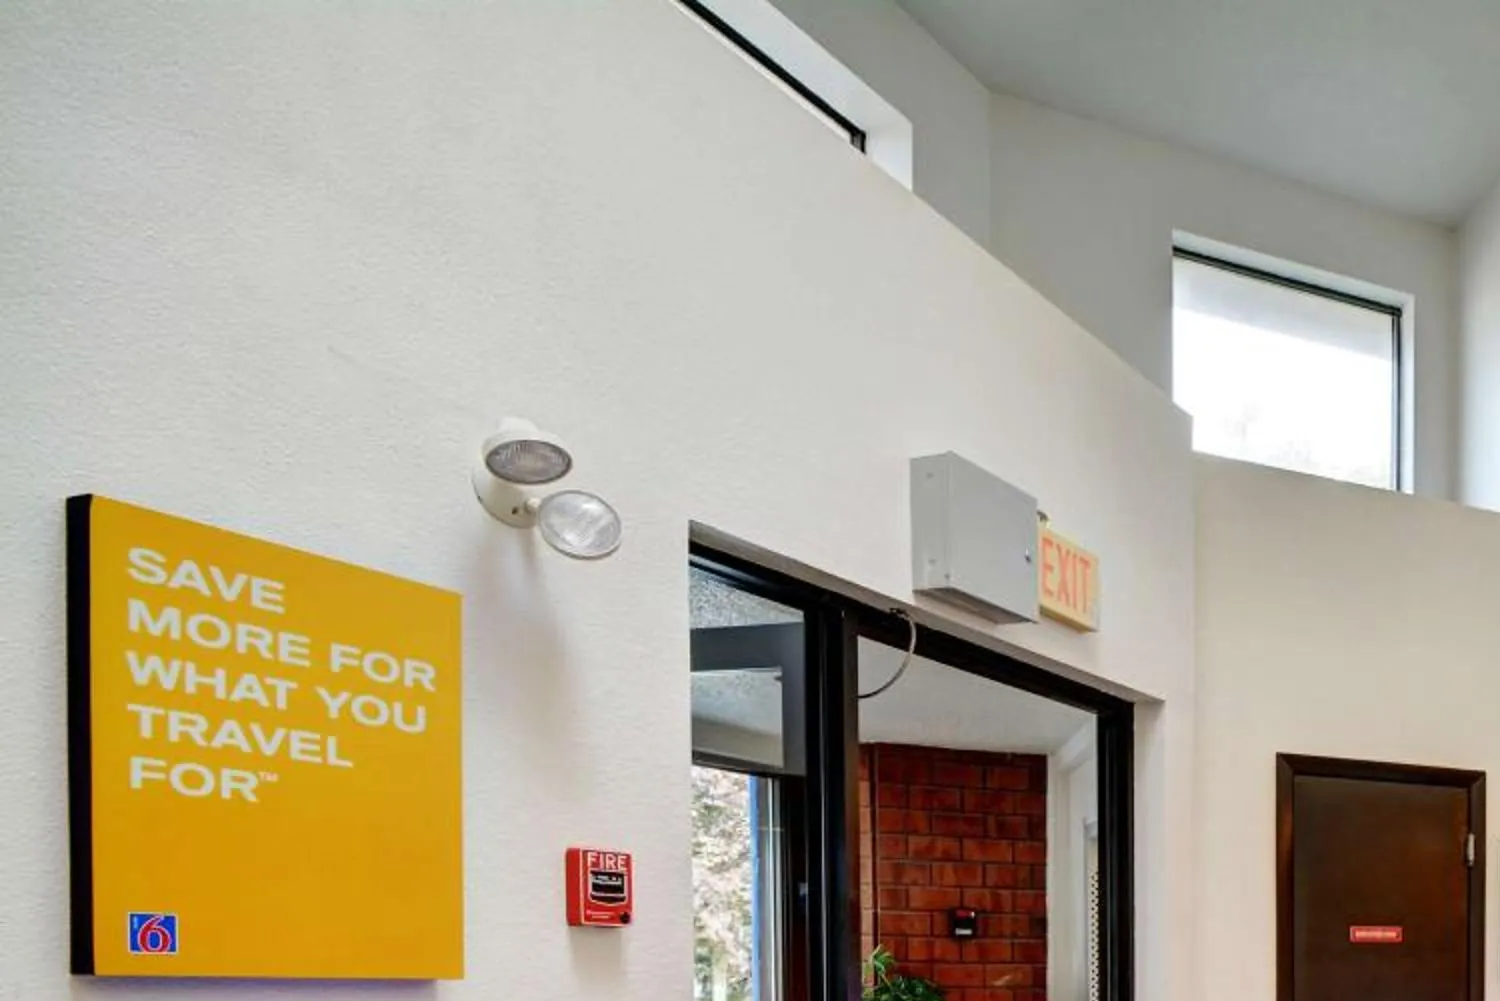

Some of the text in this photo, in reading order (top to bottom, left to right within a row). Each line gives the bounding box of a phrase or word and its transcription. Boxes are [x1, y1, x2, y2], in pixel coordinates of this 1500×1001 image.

[127, 548, 285, 614] SAVE
[1042, 535, 1091, 614] EXIT
[127, 599, 436, 692] MORE FOR
[125, 651, 426, 734] WHAT YOU
[127, 703, 353, 768] TRAVEL
[587, 851, 627, 871] FIRE
[137, 914, 172, 954] 6
